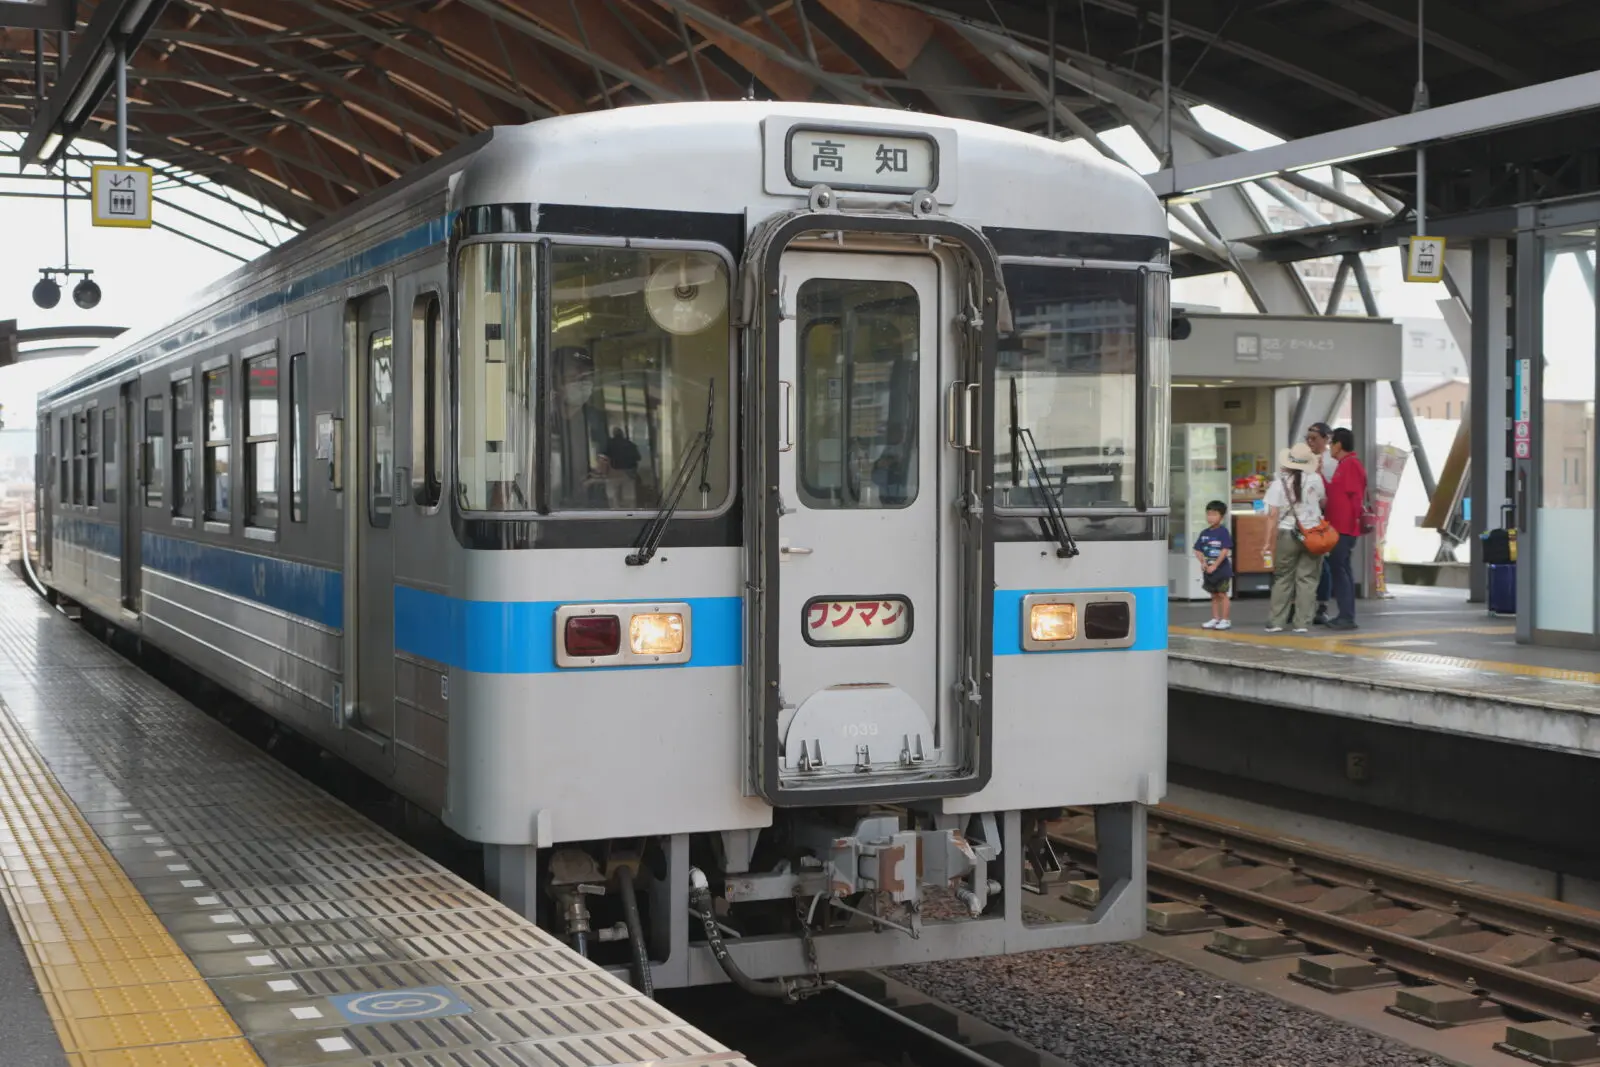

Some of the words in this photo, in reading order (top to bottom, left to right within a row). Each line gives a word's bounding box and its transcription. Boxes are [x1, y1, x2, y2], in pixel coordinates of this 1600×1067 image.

[811, 140, 908, 174] 高知
[807, 601, 904, 629] ワンマン
[842, 723, 879, 738] 1039
